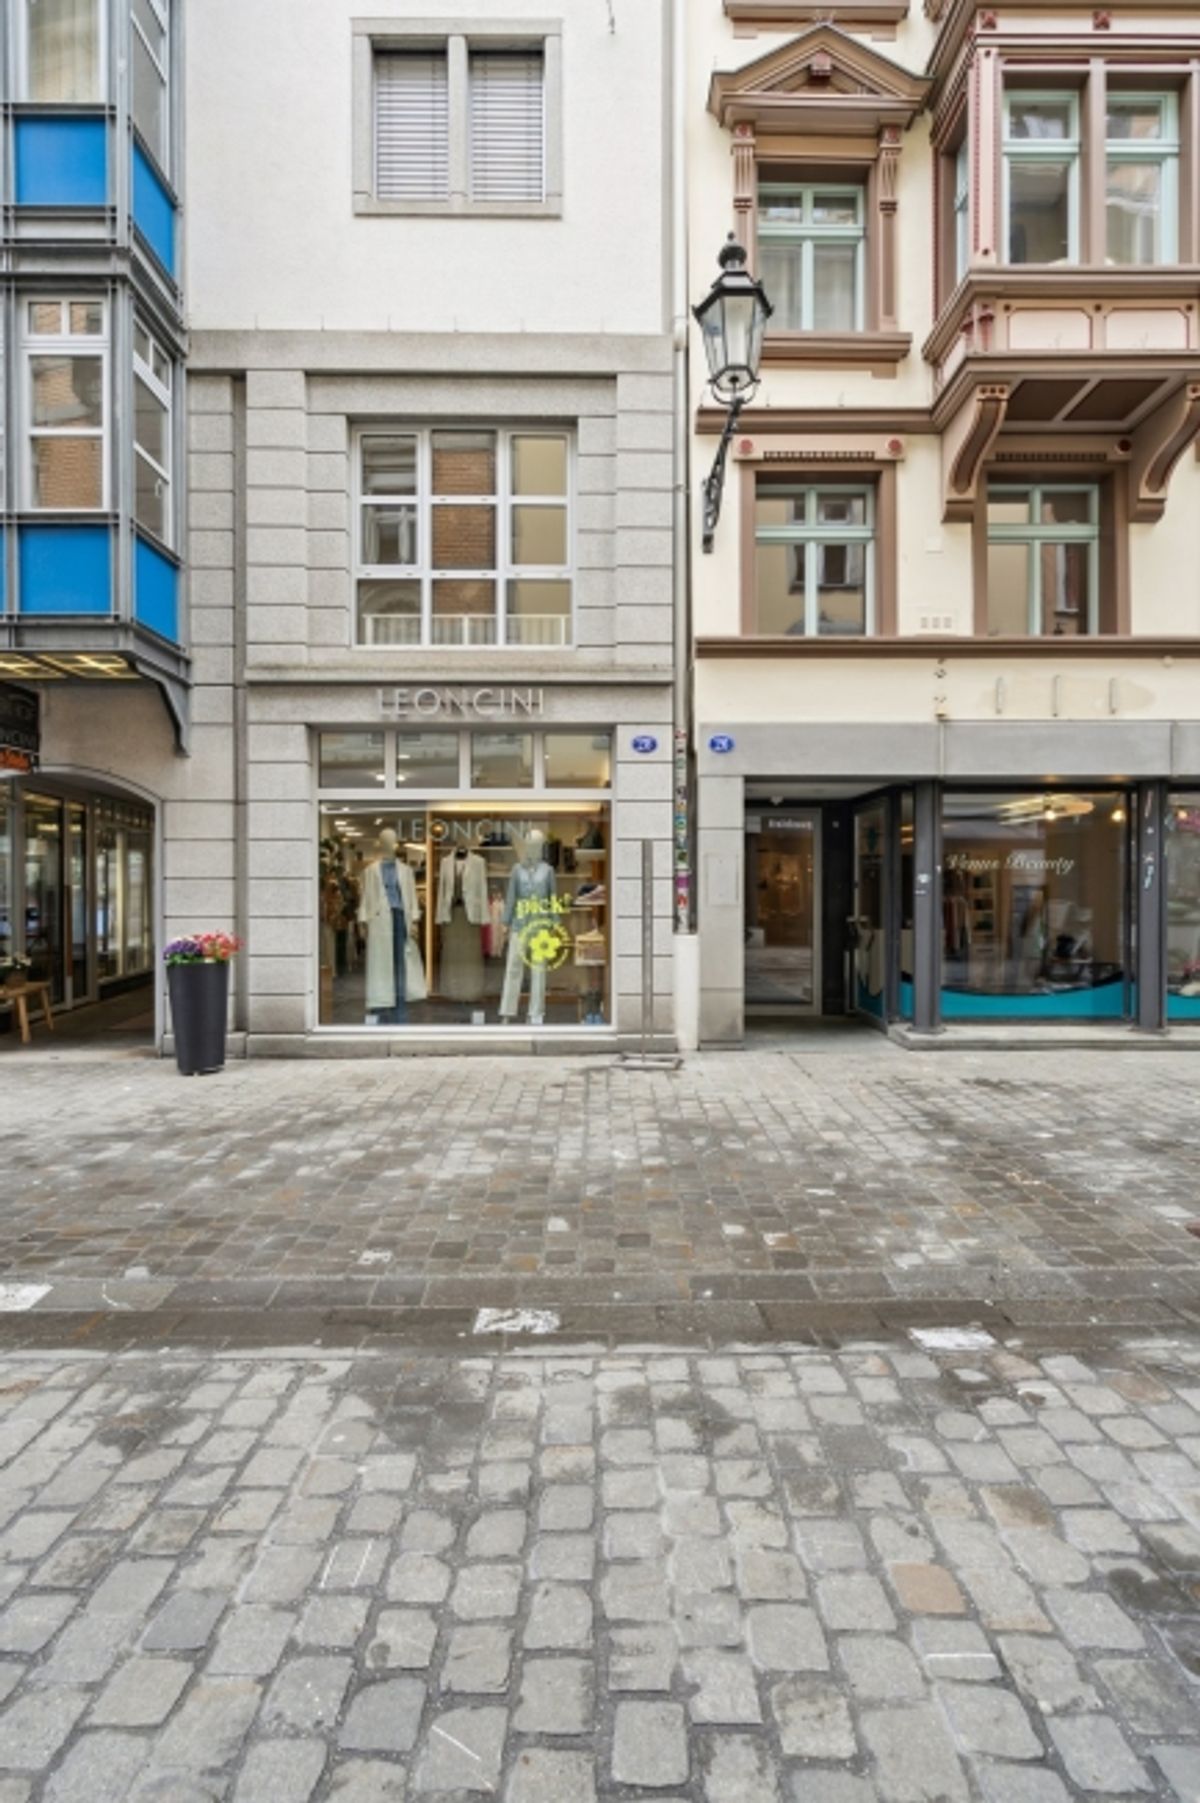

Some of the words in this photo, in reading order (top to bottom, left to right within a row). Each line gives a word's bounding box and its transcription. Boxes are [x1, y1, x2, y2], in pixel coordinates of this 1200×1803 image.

[376, 688, 544, 716] LEONCINI
[398, 818, 534, 842] LEONCINI
[1005, 852, 1075, 876] Beauty
